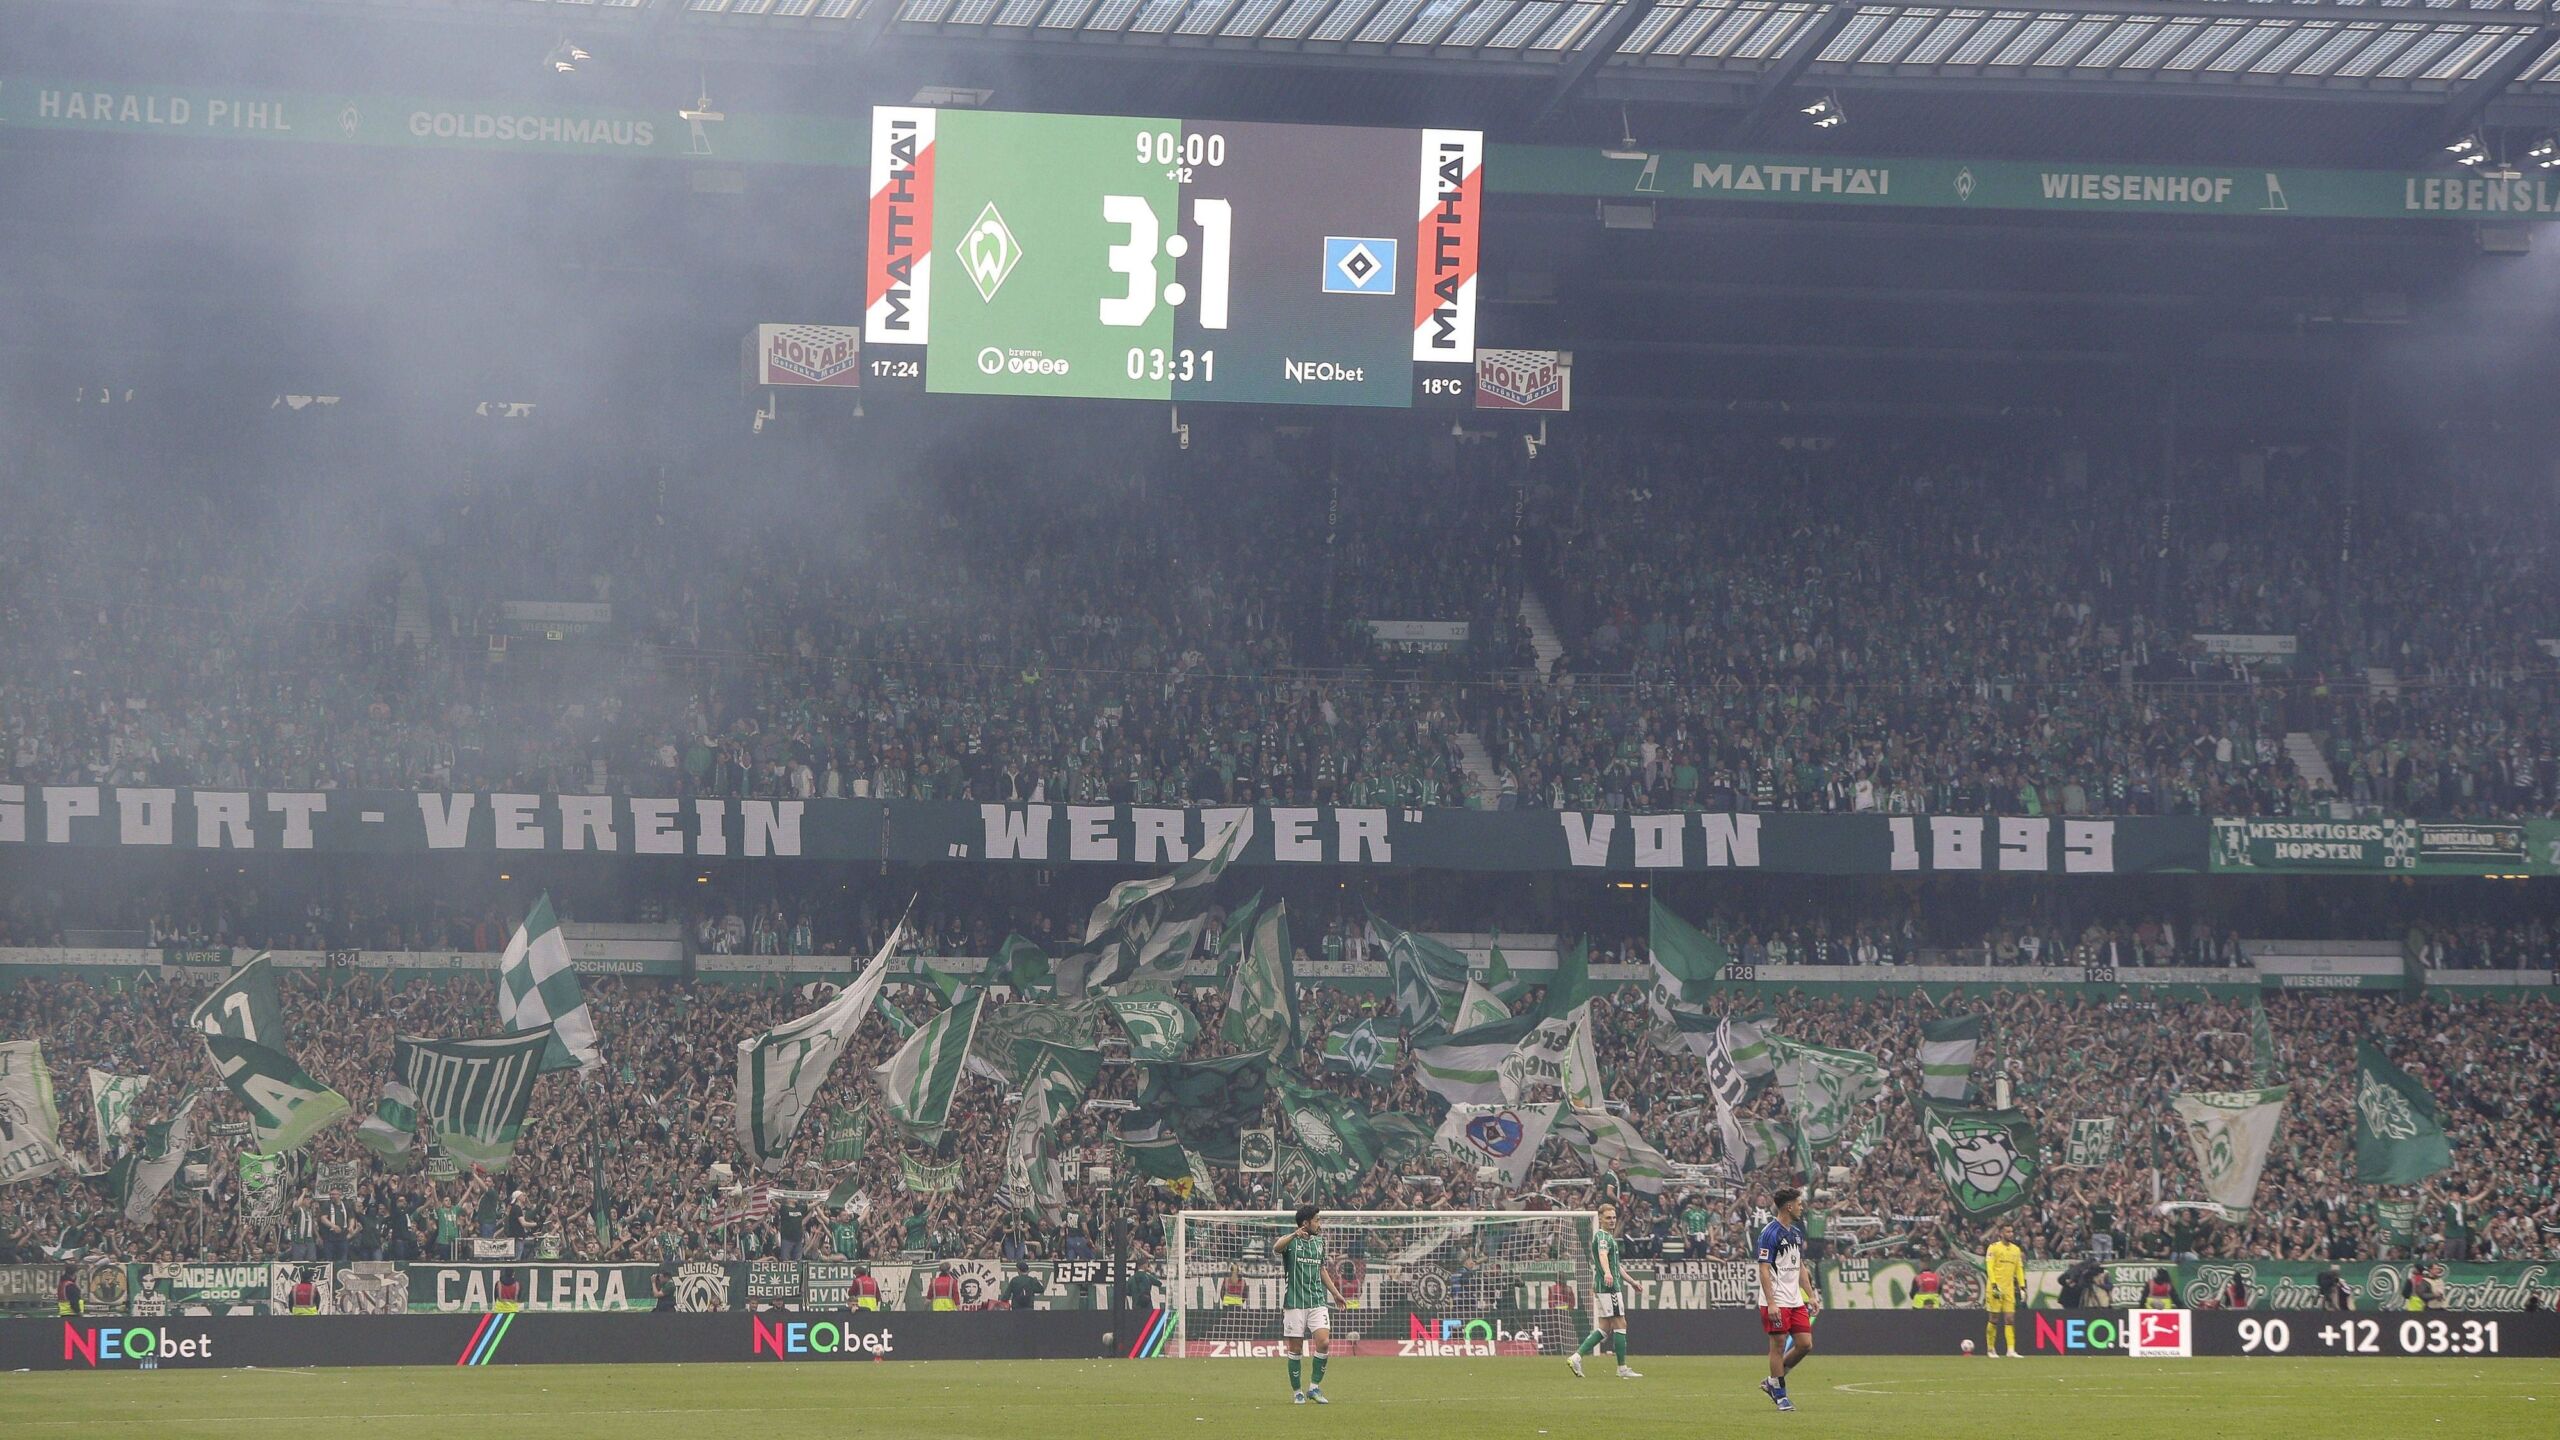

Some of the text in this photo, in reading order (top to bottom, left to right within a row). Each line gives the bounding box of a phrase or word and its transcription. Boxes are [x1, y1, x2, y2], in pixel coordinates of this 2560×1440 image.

[38, 90, 293, 131] HARALD PIHL
[408, 110, 655, 147] GOLDSCHMAUS
[1135, 131, 1226, 167] 90:00
[1165, 167, 1194, 184] +12
[1692, 161, 1889, 195] MATTHÄI
[2040, 172, 2233, 203] WIESENHOF
[884, 119, 918, 332] MATTHÄI
[1431, 142, 1465, 350] MATTHÄI
[1008, 347, 1043, 358] bremen
[870, 359, 919, 378] 17:24
[1126, 347, 1215, 382] 03:31
[1421, 378, 1462, 395] 18°C
[418, 793, 805, 857] VEREIN
[2249, 823, 2384, 841] WESERTIGERS
[1560, 811, 1762, 867] VON
[1889, 816, 2116, 872] 1899
[2275, 842, 2364, 860] HOPSTEN
[186, 951, 222, 962] WEYHE
[1726, 966, 1754, 980] 128
[2086, 968, 2113, 982] 126
[2282, 975, 2362, 987] WIESENHOF
[173, 1266, 269, 1288] ENDEAVOUR
[683, 1262, 720, 1276] ULTRAS
[751, 1262, 799, 1274] CREME
[1056, 1261, 1101, 1283] GSF
[2114, 1266, 2157, 1283] SEKTIO
[750, 1274, 767, 1285] DE
[747, 1285, 801, 1297] BREMEN
[1323, 1314, 1330, 1327] 3
[2237, 1318, 2500, 1354] 90 +12 03:31
[1209, 1340, 1311, 1357] Zillertl
[1397, 1339, 1497, 1357] Zillertal
